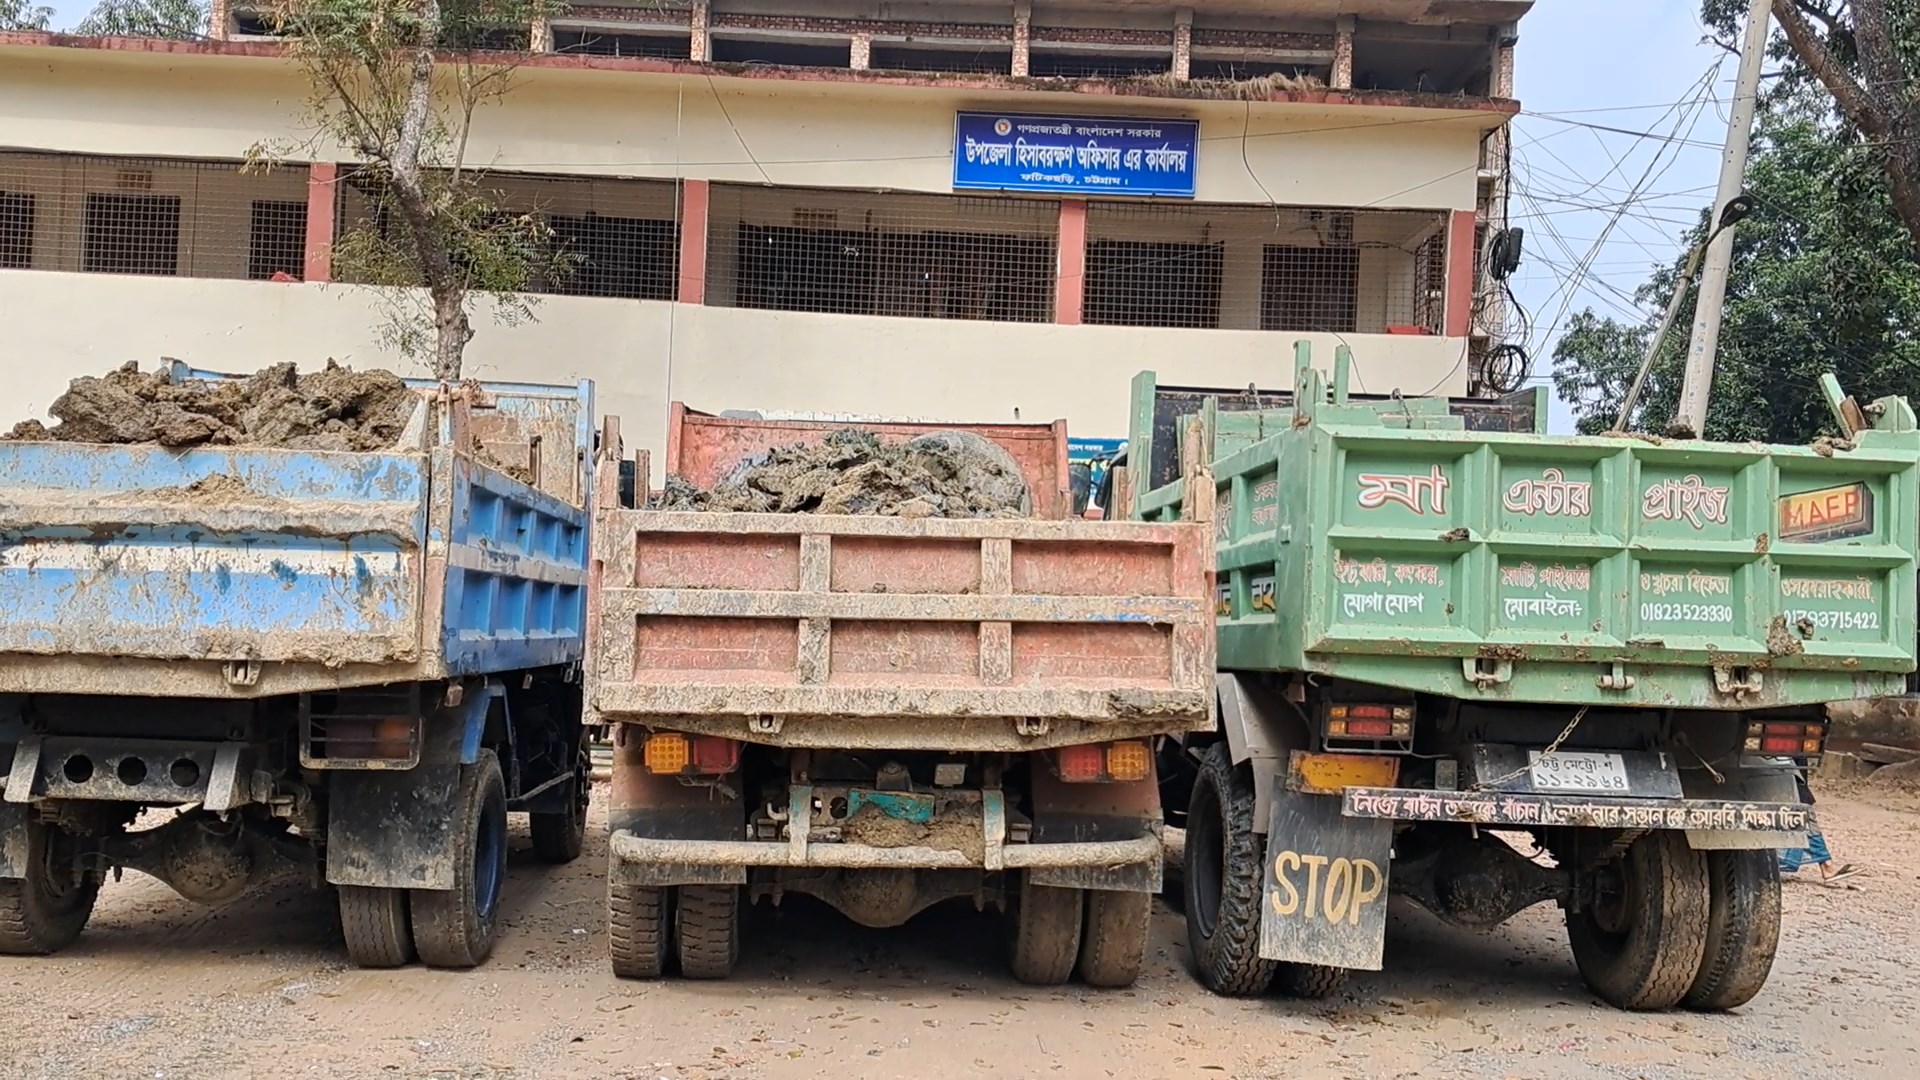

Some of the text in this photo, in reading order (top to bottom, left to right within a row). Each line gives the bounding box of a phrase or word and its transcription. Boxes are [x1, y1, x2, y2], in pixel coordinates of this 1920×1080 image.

[1017, 122, 1162, 139] গণপ্রজাতন্ত্রী বাংলাদেশ সরকার
[965, 135, 1188, 174] উপজেলা হিসাবরক্ষণ অফিসার এর কার্যালয়
[1502, 468, 1593, 517] এন্টার
[1642, 473, 1731, 530] প্রাইজ
[1640, 572, 1651, 591] ও
[1652, 572, 1684, 597] খুচরা
[1686, 568, 1730, 598] বিক্রেতা
[1640, 602, 1733, 622] 01823523330
[1536, 773, 1625, 788] ১১-২৯৬৪
[1352, 789, 1402, 816] নিজে
[1499, 796, 1541, 822] বাঁচান
[1622, 806, 1665, 826] সন্তান
[1666, 806, 1688, 826] কে
[1690, 803, 1737, 827] আরবি
[1272, 850, 1383, 925] STOP
